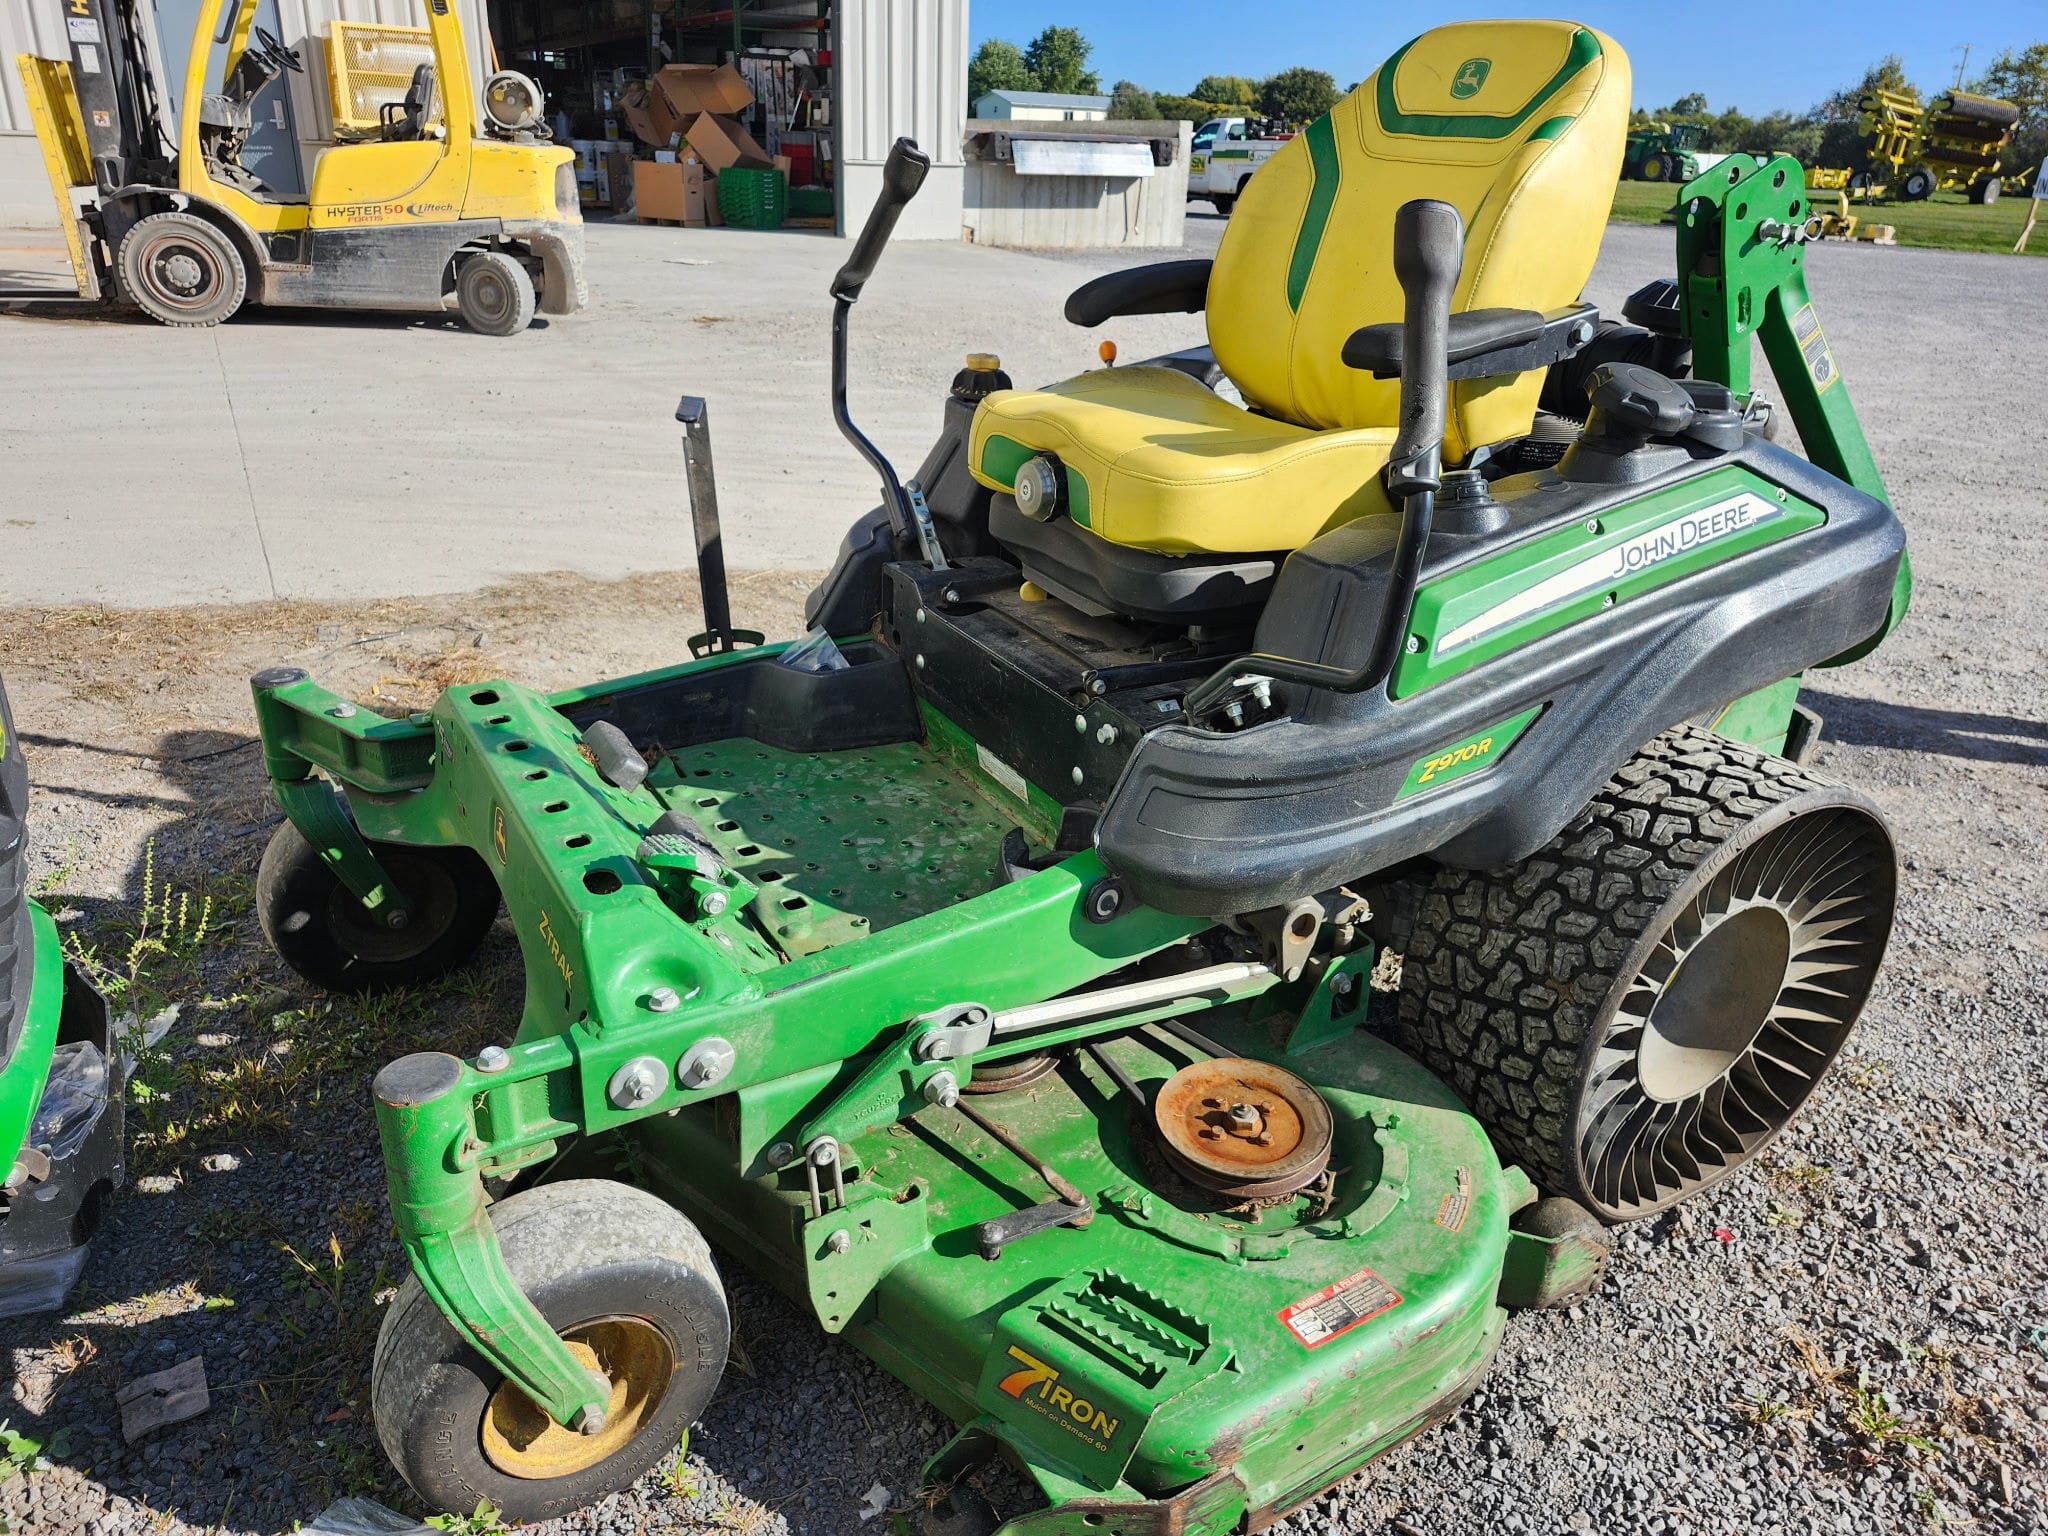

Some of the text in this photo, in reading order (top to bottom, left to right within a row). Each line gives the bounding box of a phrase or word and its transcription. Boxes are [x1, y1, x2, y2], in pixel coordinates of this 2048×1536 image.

[327, 202, 453, 218] HYSTER 50 Liftech
[1613, 502, 1750, 574] JOHN DEERE
[1417, 737, 1492, 784] Z970R
[539, 908, 575, 990] ZTRAK
[644, 1284, 714, 1374] CARLISLE
[1024, 1396, 1049, 1415] Mulch
[1048, 1411, 1060, 1422] on
[1059, 1419, 1095, 1445] Demand
